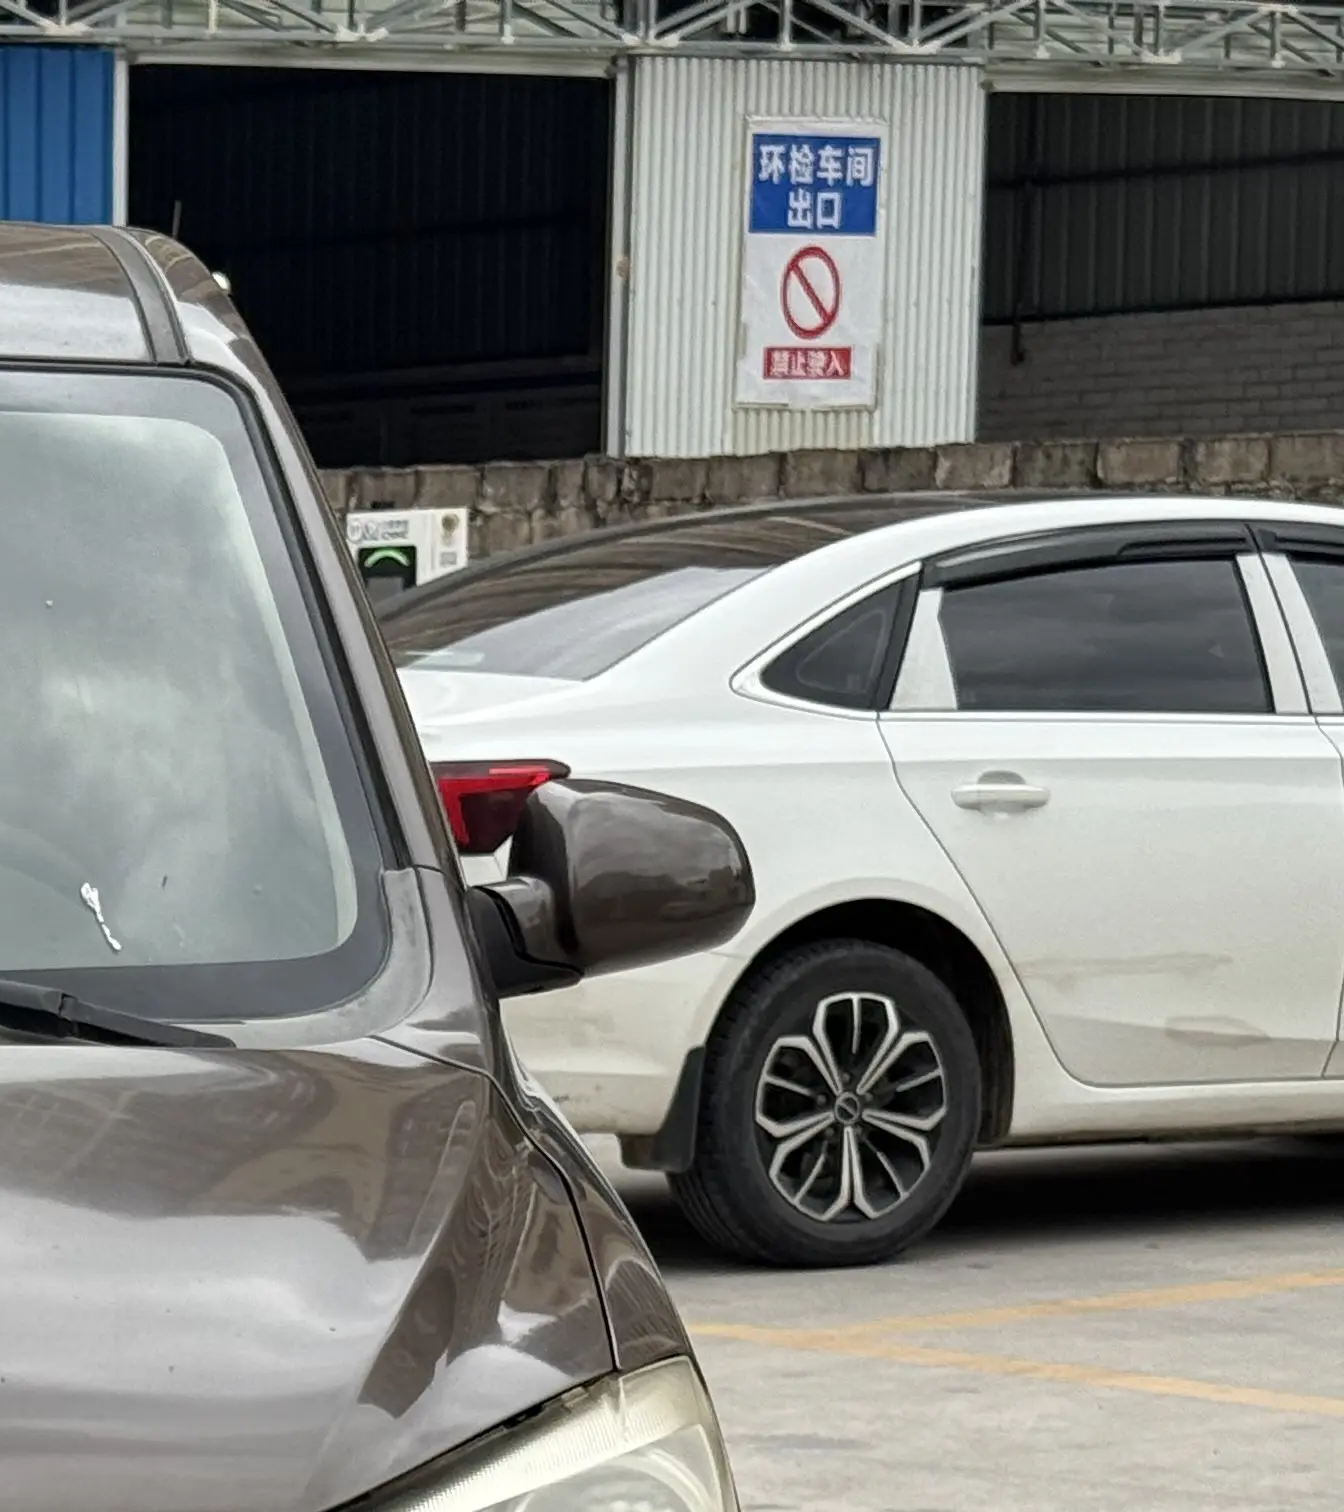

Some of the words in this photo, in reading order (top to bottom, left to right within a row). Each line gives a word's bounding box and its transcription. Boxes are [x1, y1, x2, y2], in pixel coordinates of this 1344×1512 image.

[758, 144, 874, 187] 环检车间
[787, 188, 841, 229] 出口
